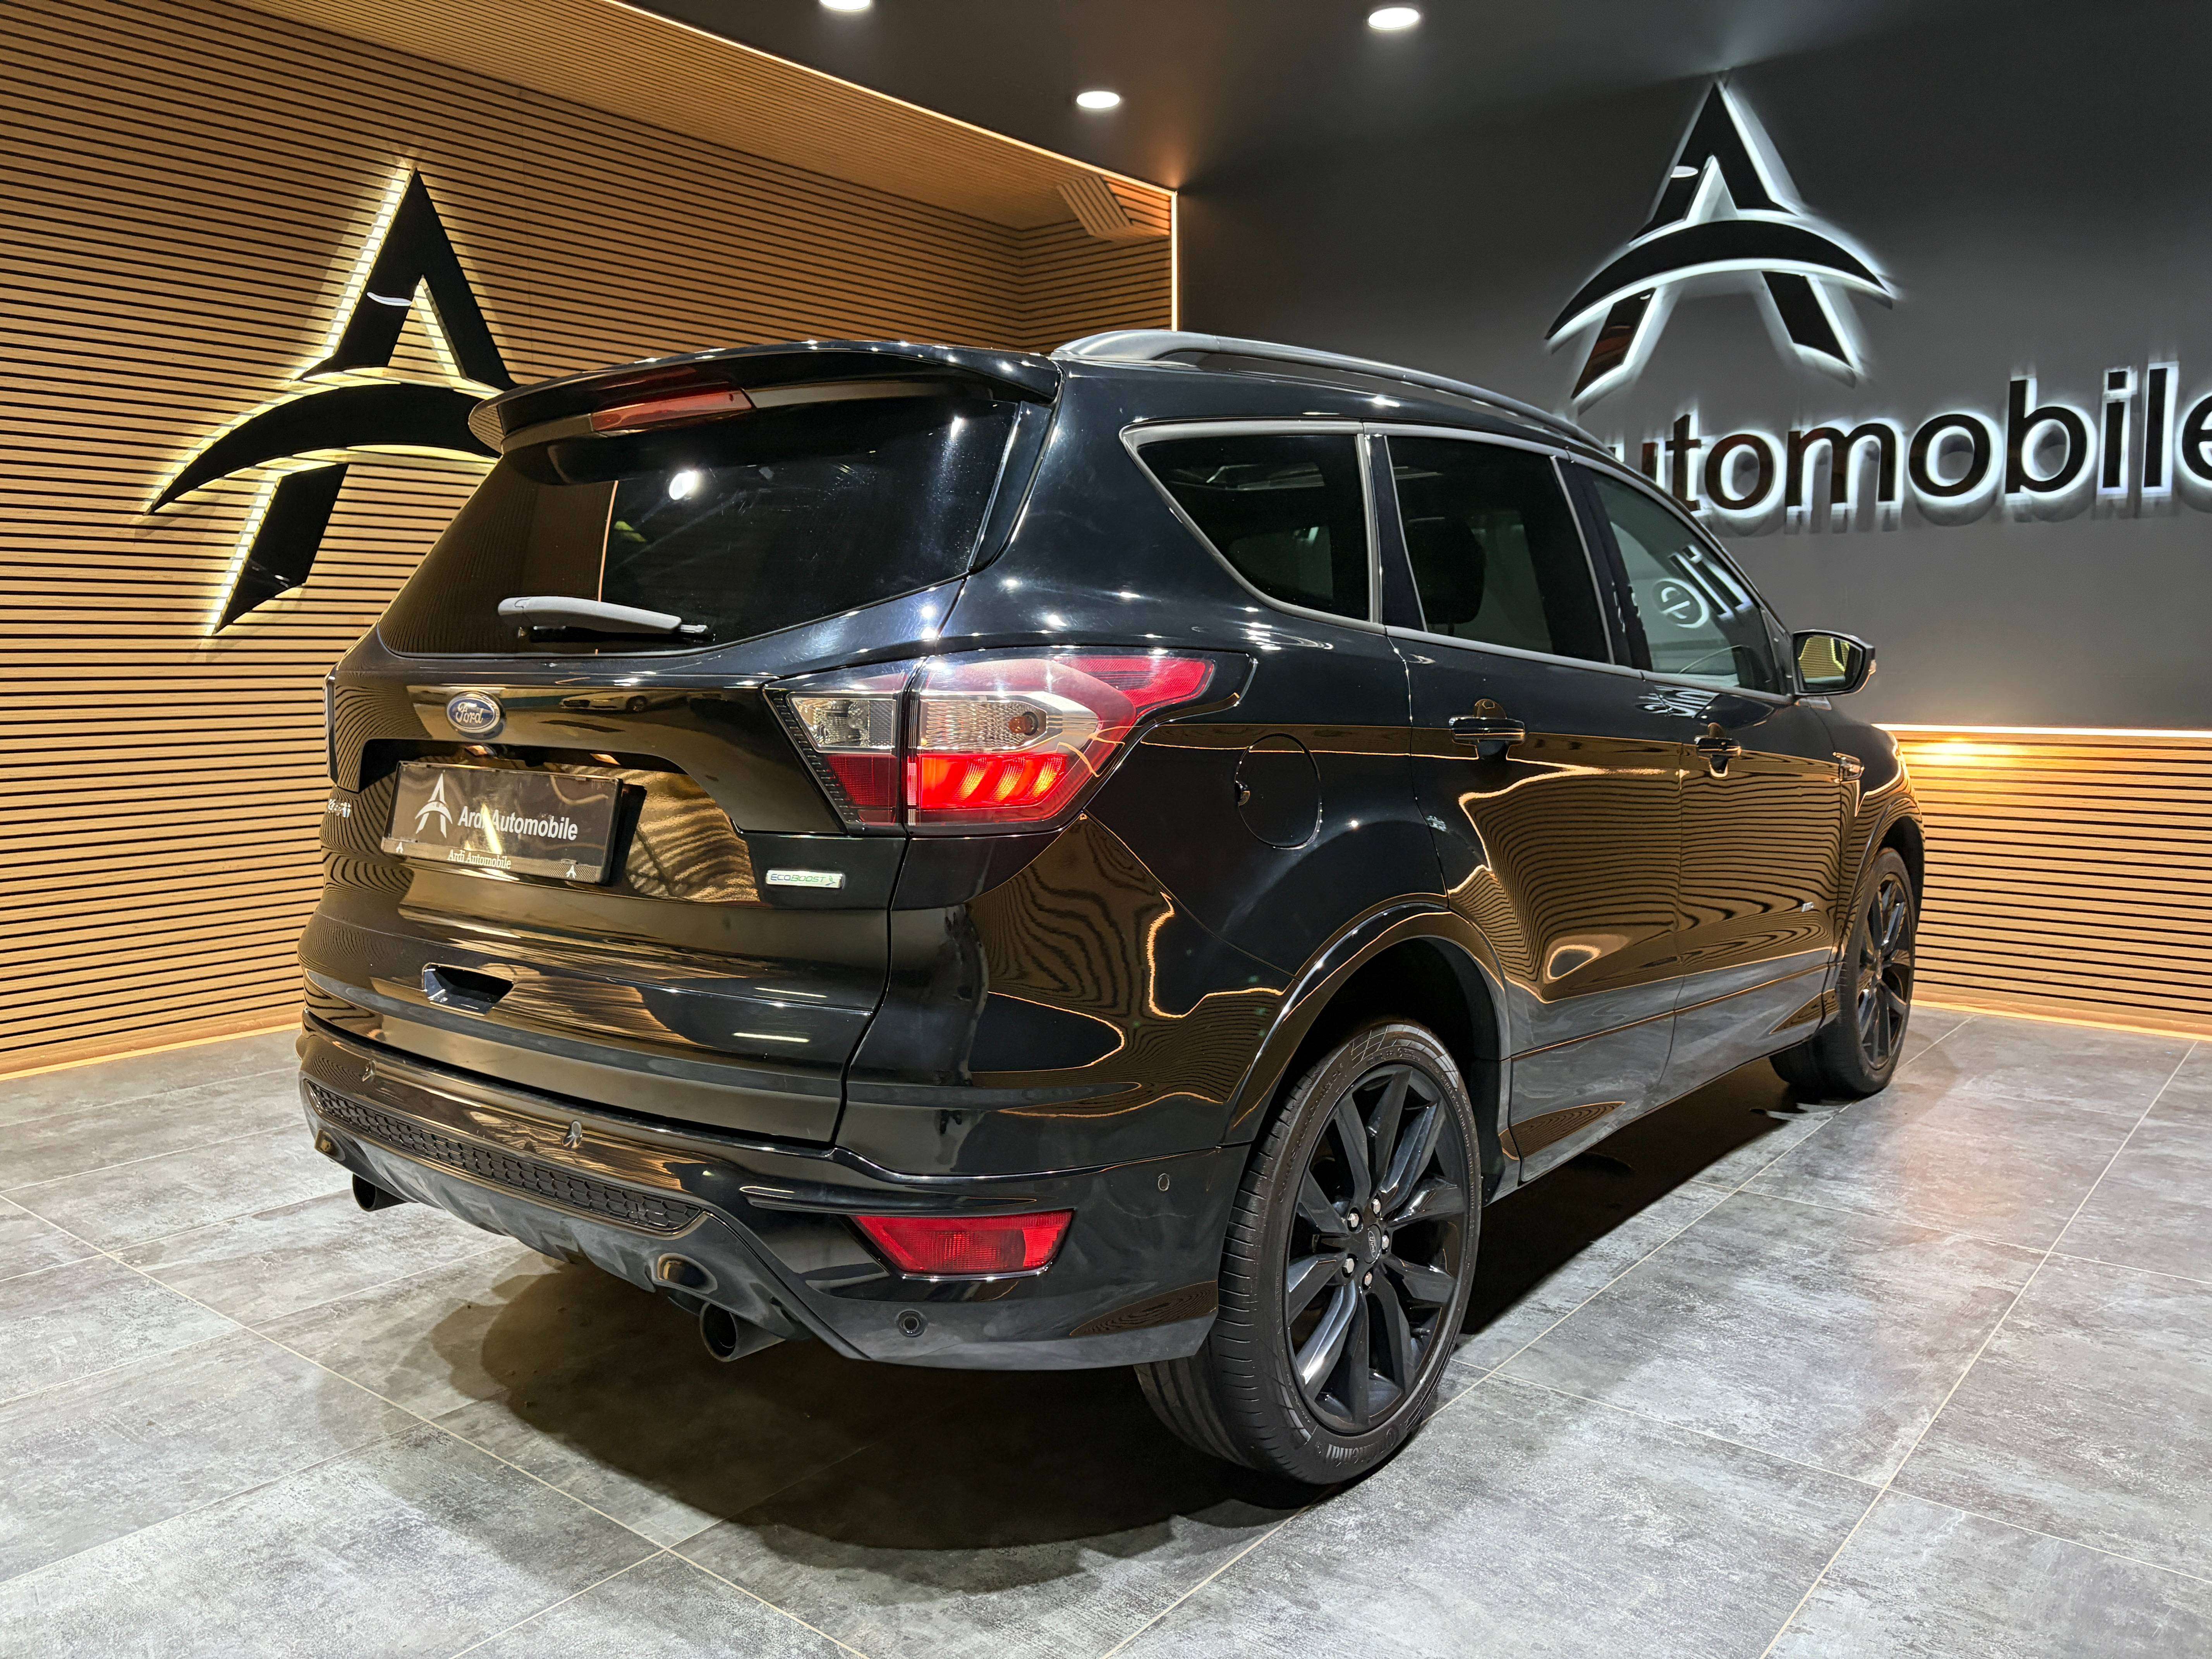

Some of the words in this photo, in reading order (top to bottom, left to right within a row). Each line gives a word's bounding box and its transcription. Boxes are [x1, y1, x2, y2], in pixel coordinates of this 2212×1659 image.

[455, 702, 484, 724] Ford
[492, 809, 578, 841] Automobile
[447, 849, 465, 863] Ardi
[465, 852, 512, 869] Automobile
